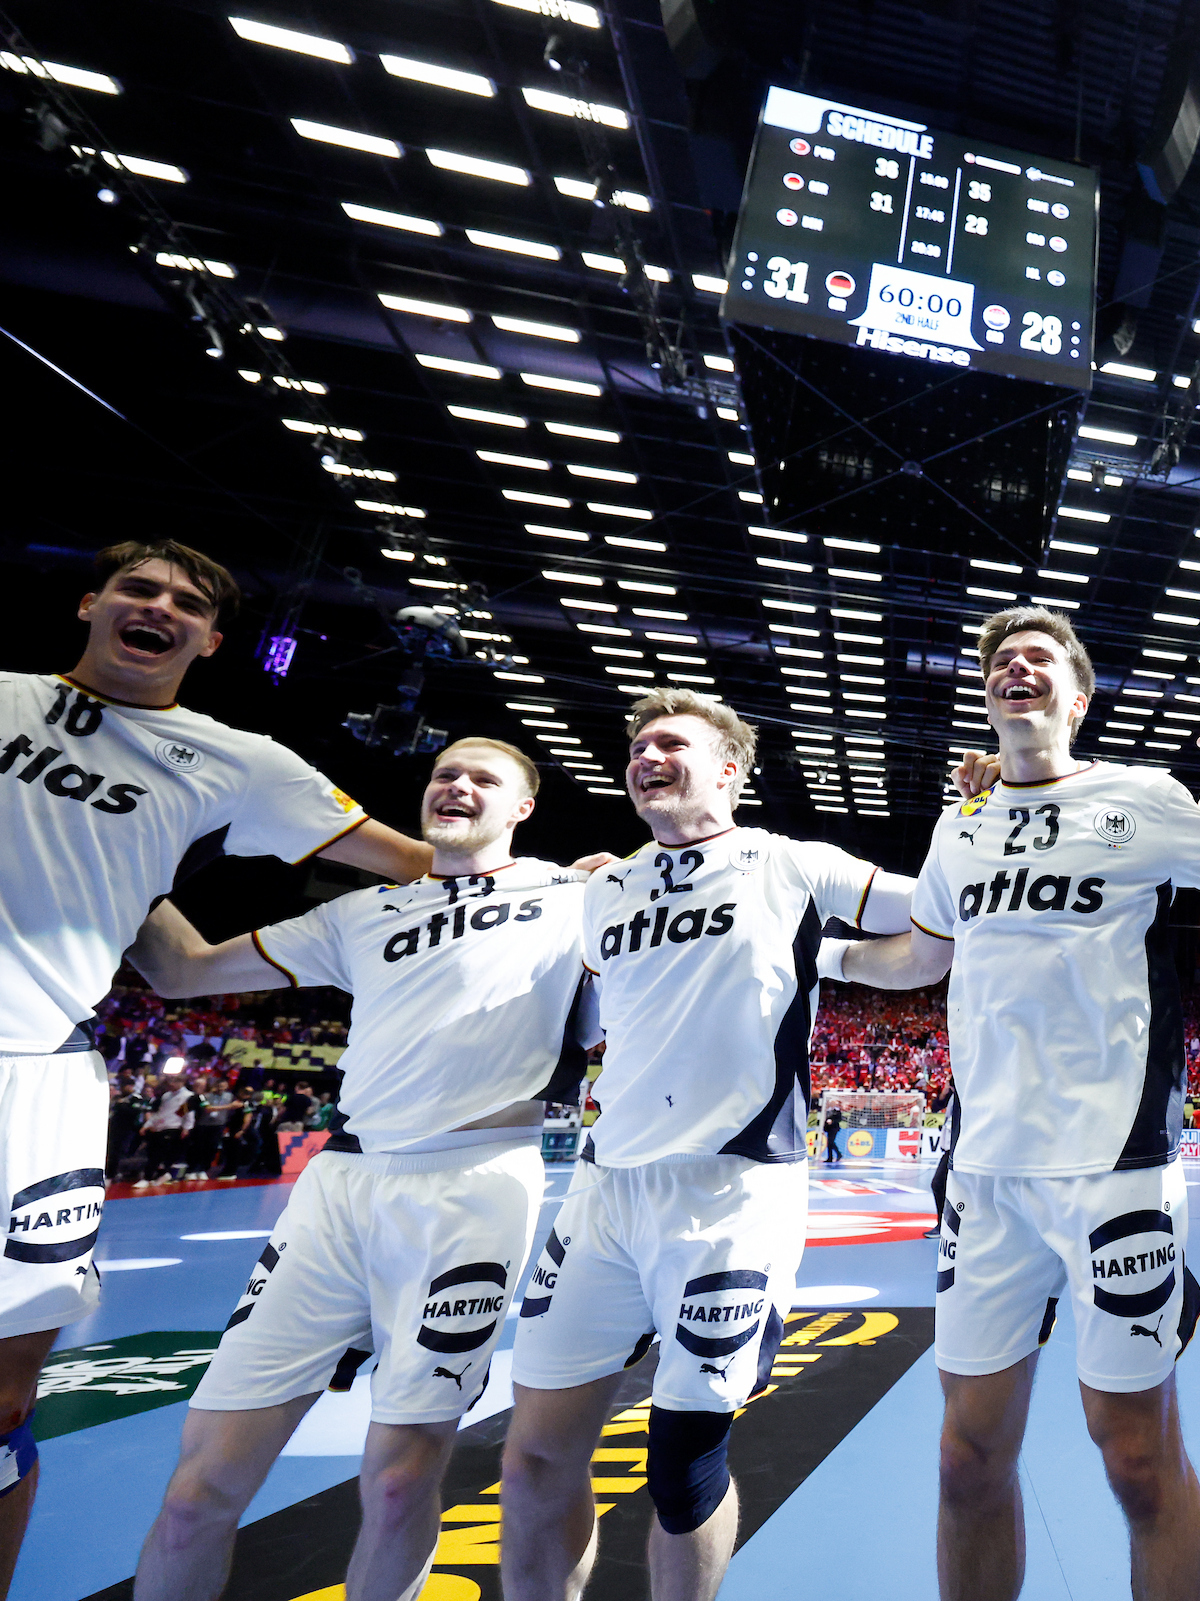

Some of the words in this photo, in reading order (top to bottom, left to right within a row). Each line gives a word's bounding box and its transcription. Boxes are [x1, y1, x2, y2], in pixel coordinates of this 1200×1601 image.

[827, 111, 934, 160] SCHEDULE
[869, 191, 894, 214] 31
[968, 180, 992, 202] 35
[964, 213, 989, 236] 28
[763, 256, 809, 305] 31
[879, 284, 962, 317] 60:00
[917, 315, 940, 331] HALF
[1019, 311, 1063, 355] 28
[855, 326, 971, 367] Hisense
[45, 683, 107, 737] 18
[0, 734, 149, 815] tlas
[1003, 803, 1061, 856] 23
[442, 876, 495, 905] 13
[650, 850, 705, 902] 32
[958, 867, 1107, 922] atlas
[383, 897, 543, 963] atlas
[600, 903, 737, 961] atlas
[1180, 1144, 1198, 1156] OLY
[1091, 1242, 1176, 1279] HARTING
[422, 1295, 504, 1319] HARTING
[679, 1298, 765, 1322] HARTING
